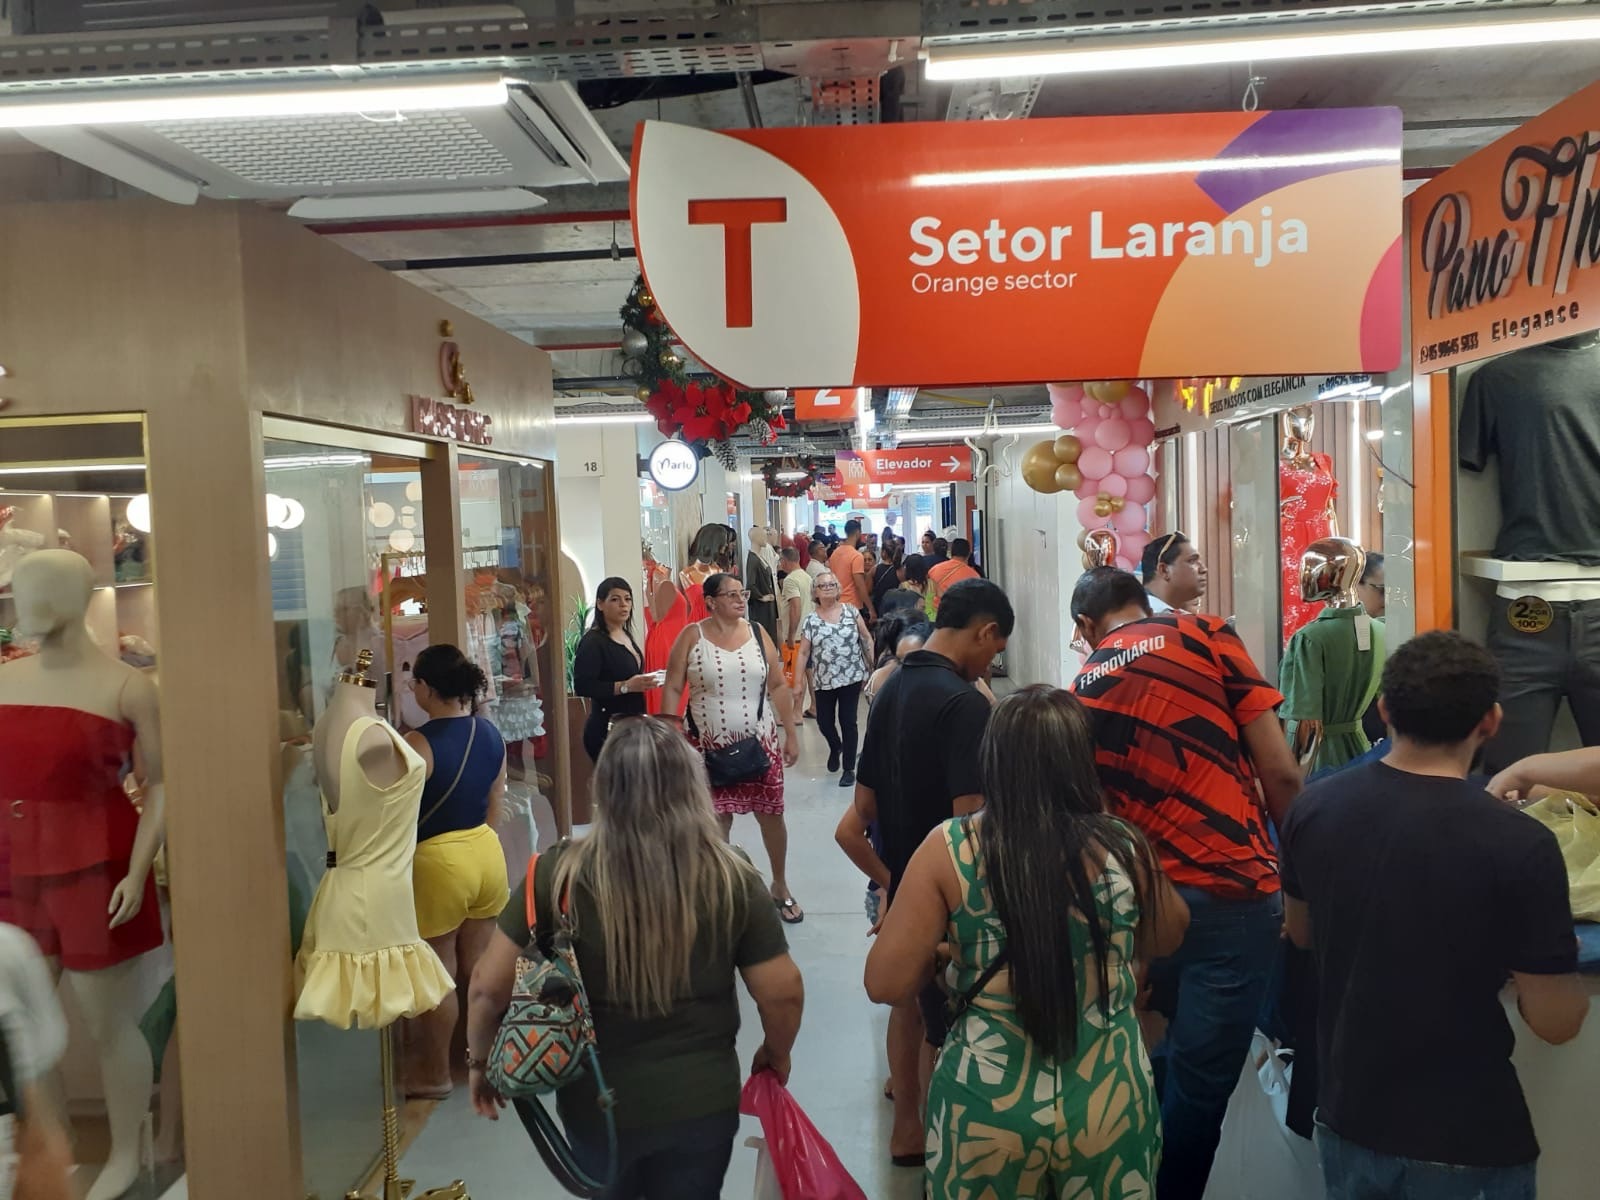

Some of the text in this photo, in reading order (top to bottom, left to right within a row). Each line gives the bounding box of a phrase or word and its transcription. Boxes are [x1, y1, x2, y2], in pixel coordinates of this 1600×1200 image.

[909, 207, 1309, 268] Setor Laranja
[688, 196, 787, 328] T
[911, 270, 1078, 296] Orange sector
[1491, 301, 1580, 342] Elegance
[1224, 391, 1246, 412] PASSOS
[1247, 388, 1263, 403] COM
[584, 462, 598, 472] 18
[876, 457, 933, 470] Elevador
[1514, 601, 1529, 618] 2
[1080, 635, 1165, 690] FERROVIÁRIO
